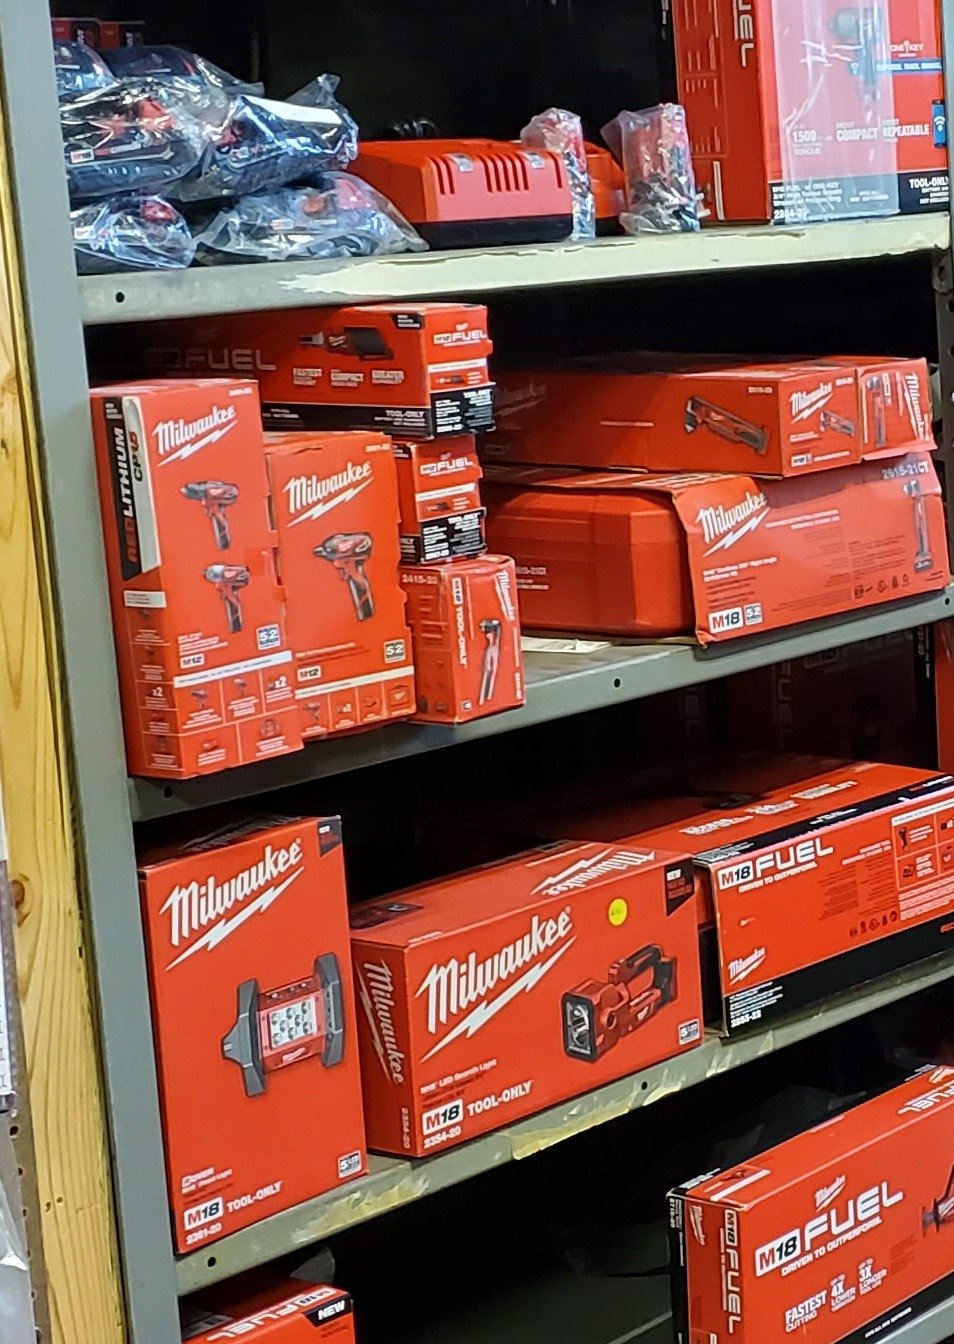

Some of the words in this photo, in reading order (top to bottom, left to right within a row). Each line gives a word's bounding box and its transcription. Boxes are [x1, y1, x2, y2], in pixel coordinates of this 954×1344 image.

[836, 126, 878, 142] COMPACT
[451, 329, 488, 342] FUEL
[789, 380, 833, 415] Milwaukee
[904, 372, 930, 441] Milwaukee
[152, 405, 237, 456] Milwaukee
[282, 460, 373, 515] Milwaukee
[436, 457, 474, 472] FUEL
[114, 426, 138, 564] REDLITHIUM
[696, 490, 769, 545] Milwaukee
[496, 569, 516, 623] Milwaukee
[712, 611, 740, 629] M18
[541, 850, 655, 897] Milwaukee
[721, 865, 751, 886] M18
[756, 838, 833, 878] FUEL
[159, 836, 303, 946] Milwaukee
[414, 906, 571, 1023] Milwaukee
[363, 958, 405, 1086] Milwaukee
[426, 1104, 460, 1131] M18
[467, 1080, 535, 1116] TOOL-ONLY
[423, 1125, 462, 1149] 2354-20
[187, 1202, 219, 1226] M18
[227, 1181, 283, 1212] TOOL-ONLY
[760, 1236, 797, 1271] M18
[804, 1180, 904, 1251] FUEL
[725, 1212, 737, 1245] M18
[781, 1253, 813, 1277] DRIVEN
[814, 1246, 826, 1259] TO
[317, 1299, 346, 1322] NEW
[724, 1248, 743, 1335] FUEL
[785, 1289, 827, 1325] FASTEST
[207, 1302, 295, 1343] FUEL
